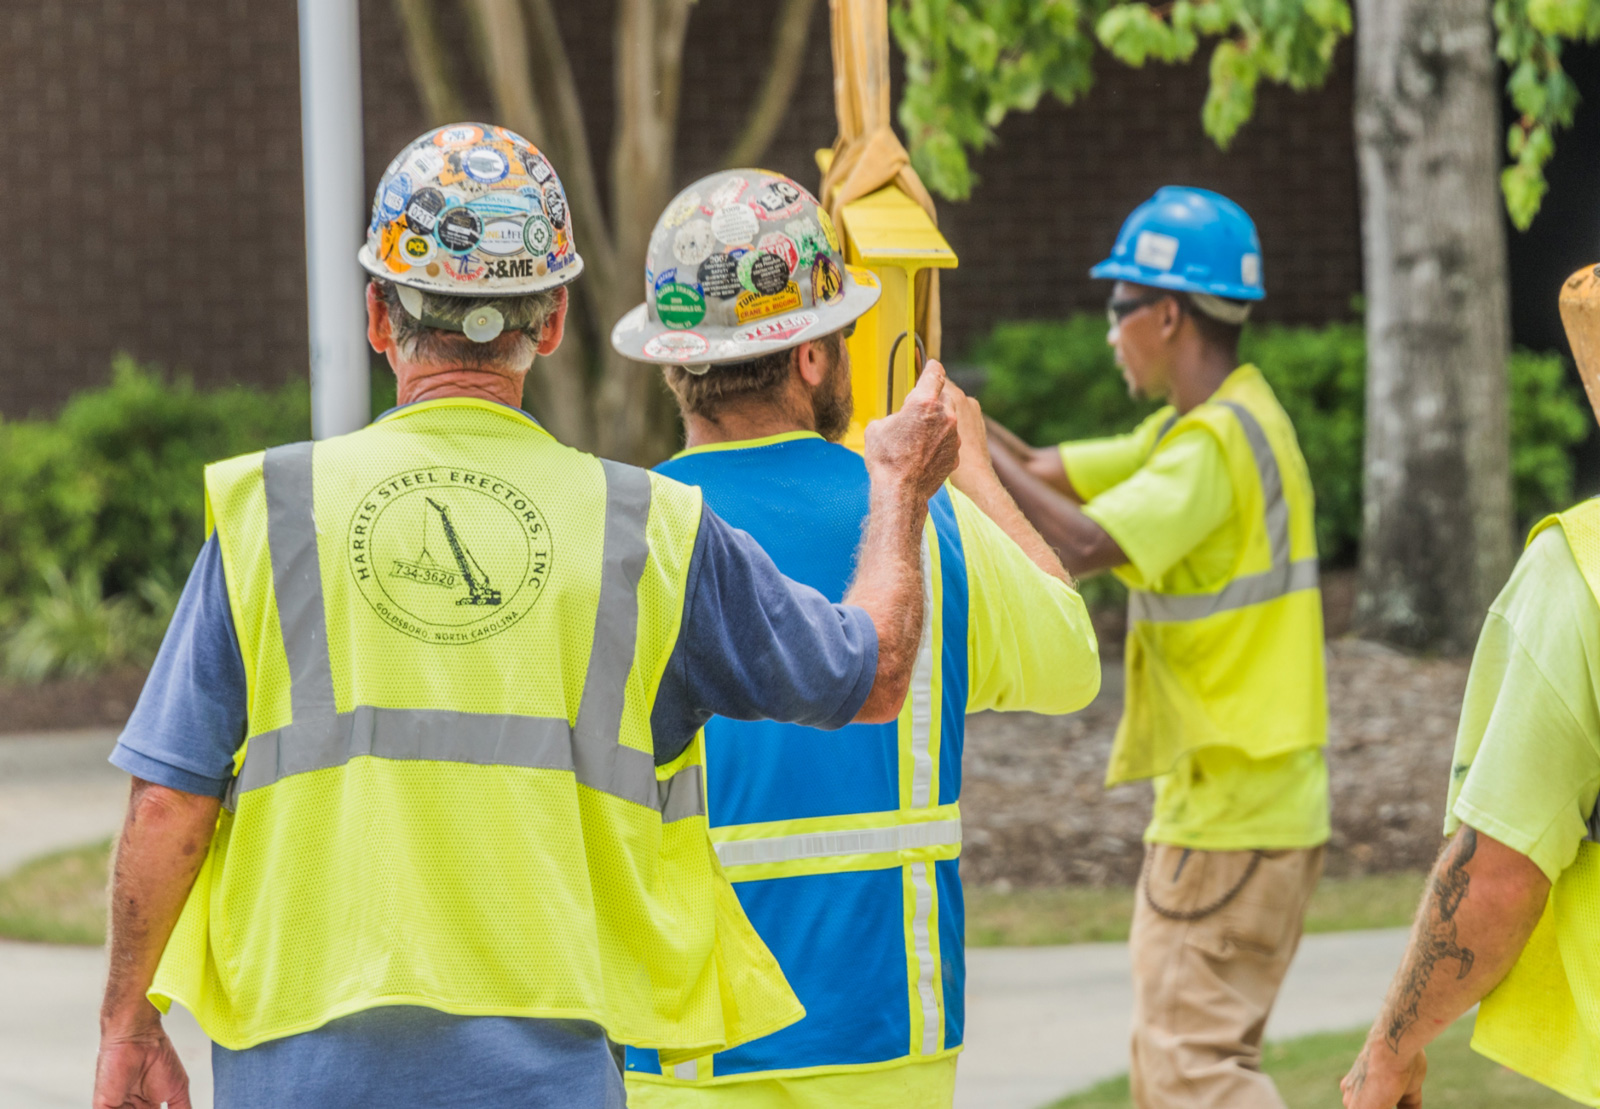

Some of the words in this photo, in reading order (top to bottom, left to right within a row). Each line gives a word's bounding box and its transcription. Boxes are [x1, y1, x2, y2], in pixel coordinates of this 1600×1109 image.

[410, 205, 435, 228] 0217
[407, 240, 427, 253] PCL
[738, 291, 763, 309] TURN
[740, 307, 763, 319] CRANE
[764, 305, 771, 313] &
[772, 297, 798, 310] RIGGING
[735, 313, 816, 340] SYSTEMS
[352, 500, 378, 582] HARRIS
[377, 471, 439, 500] STEEL
[449, 470, 543, 542] ERECTORS,
[528, 550, 547, 591] INC
[395, 564, 456, 587] 734-3620
[434, 632, 469, 642] NORTH
[470, 610, 519, 640] CAROLINA
